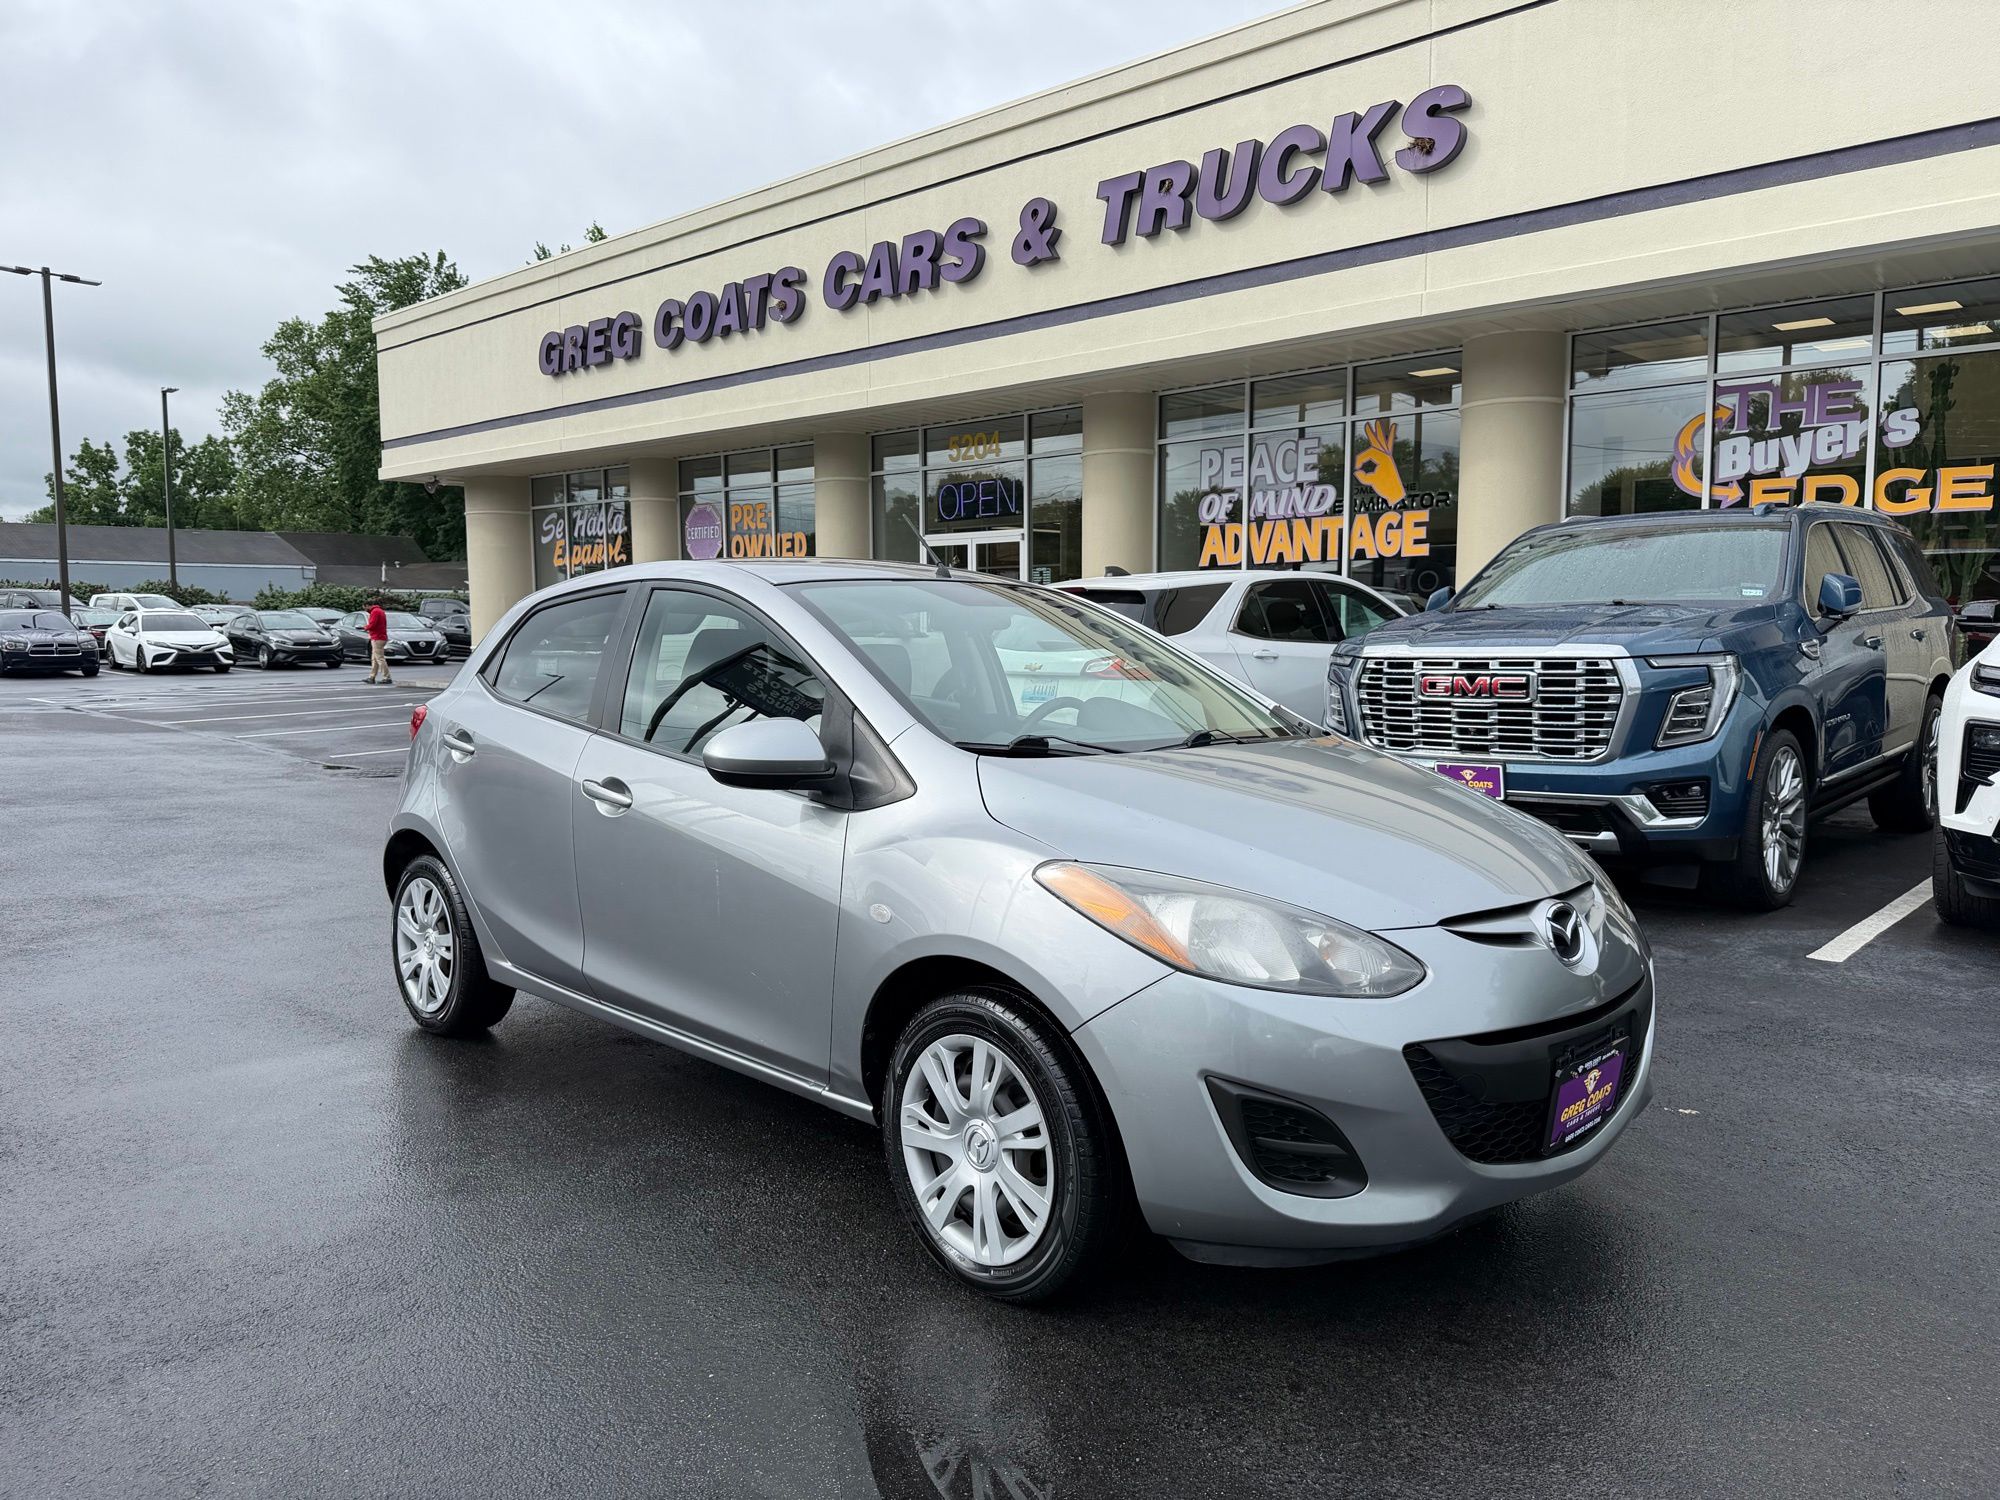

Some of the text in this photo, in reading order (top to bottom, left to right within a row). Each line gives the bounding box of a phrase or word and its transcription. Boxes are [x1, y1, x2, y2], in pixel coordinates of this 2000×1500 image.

[539, 84, 1473, 376] GREG COATS CARS & TRUCKS
[1717, 379, 1864, 434] THE
[948, 431, 1002, 462] 5204
[1200, 437, 1321, 491] PEACE
[1715, 407, 1921, 483] Buyer's
[938, 479, 1017, 520] OPEN
[1198, 484, 1337, 524] OF MIND
[1325, 487, 1451, 515] EMINATOR
[1749, 463, 1995, 516] EDGE
[541, 503, 627, 544] Se Habla
[687, 526, 720, 540] CERTIFIED
[1198, 509, 1430, 567] ADVANTAGE
[731, 531, 807, 558] OWNED
[1421, 676, 1527, 697] GMC
[1468, 780, 1494, 789] COATS
[1561, 1082, 1612, 1122] GREG COATS
